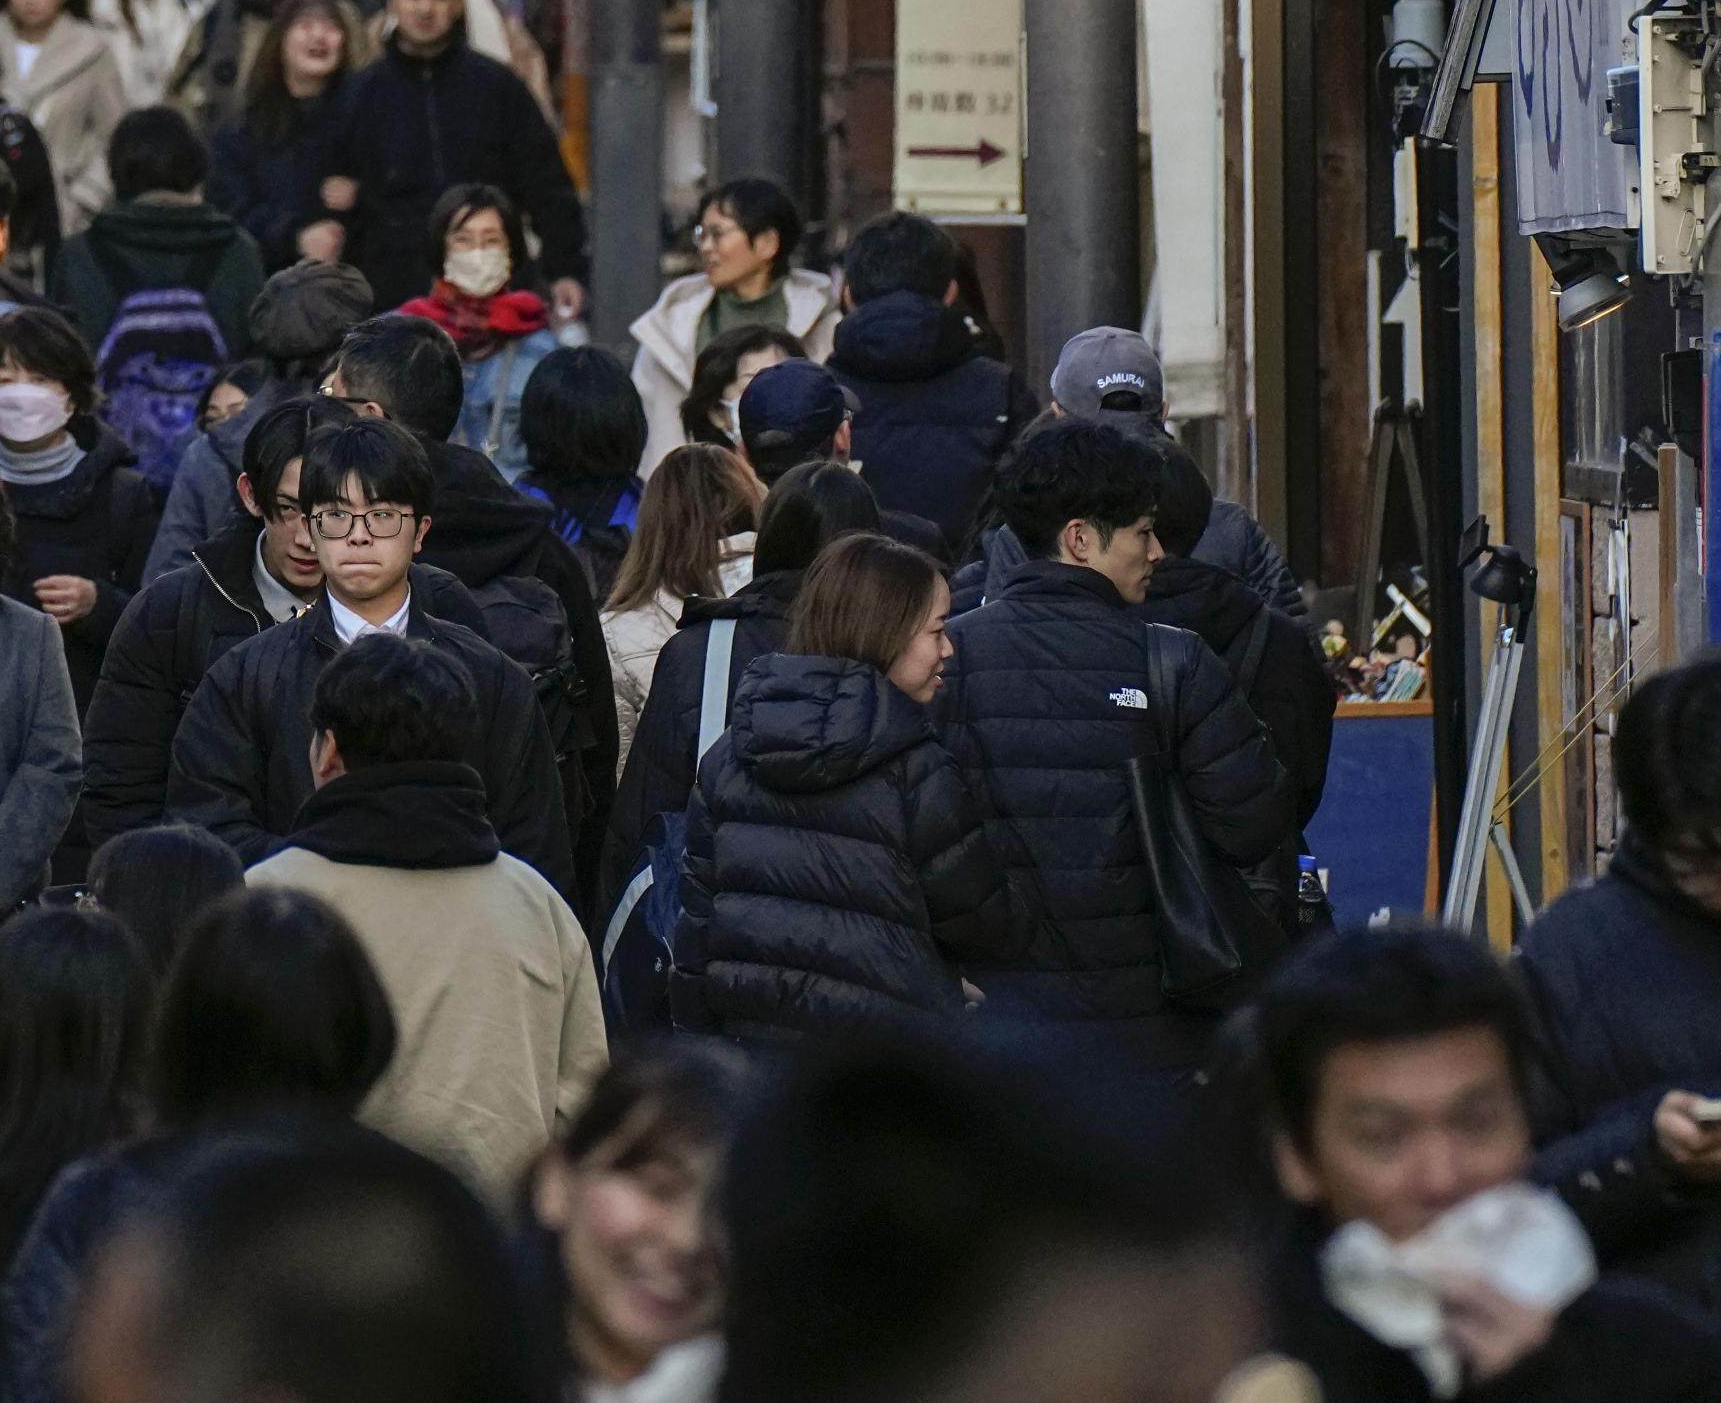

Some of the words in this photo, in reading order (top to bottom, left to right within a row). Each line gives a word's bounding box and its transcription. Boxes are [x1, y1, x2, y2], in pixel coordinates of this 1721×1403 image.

[1097, 373, 1145, 388] SAMURAI
[1121, 687, 1137, 695] THE
[1109, 692, 1136, 701] NORTH
[1116, 699, 1137, 707] FACE
